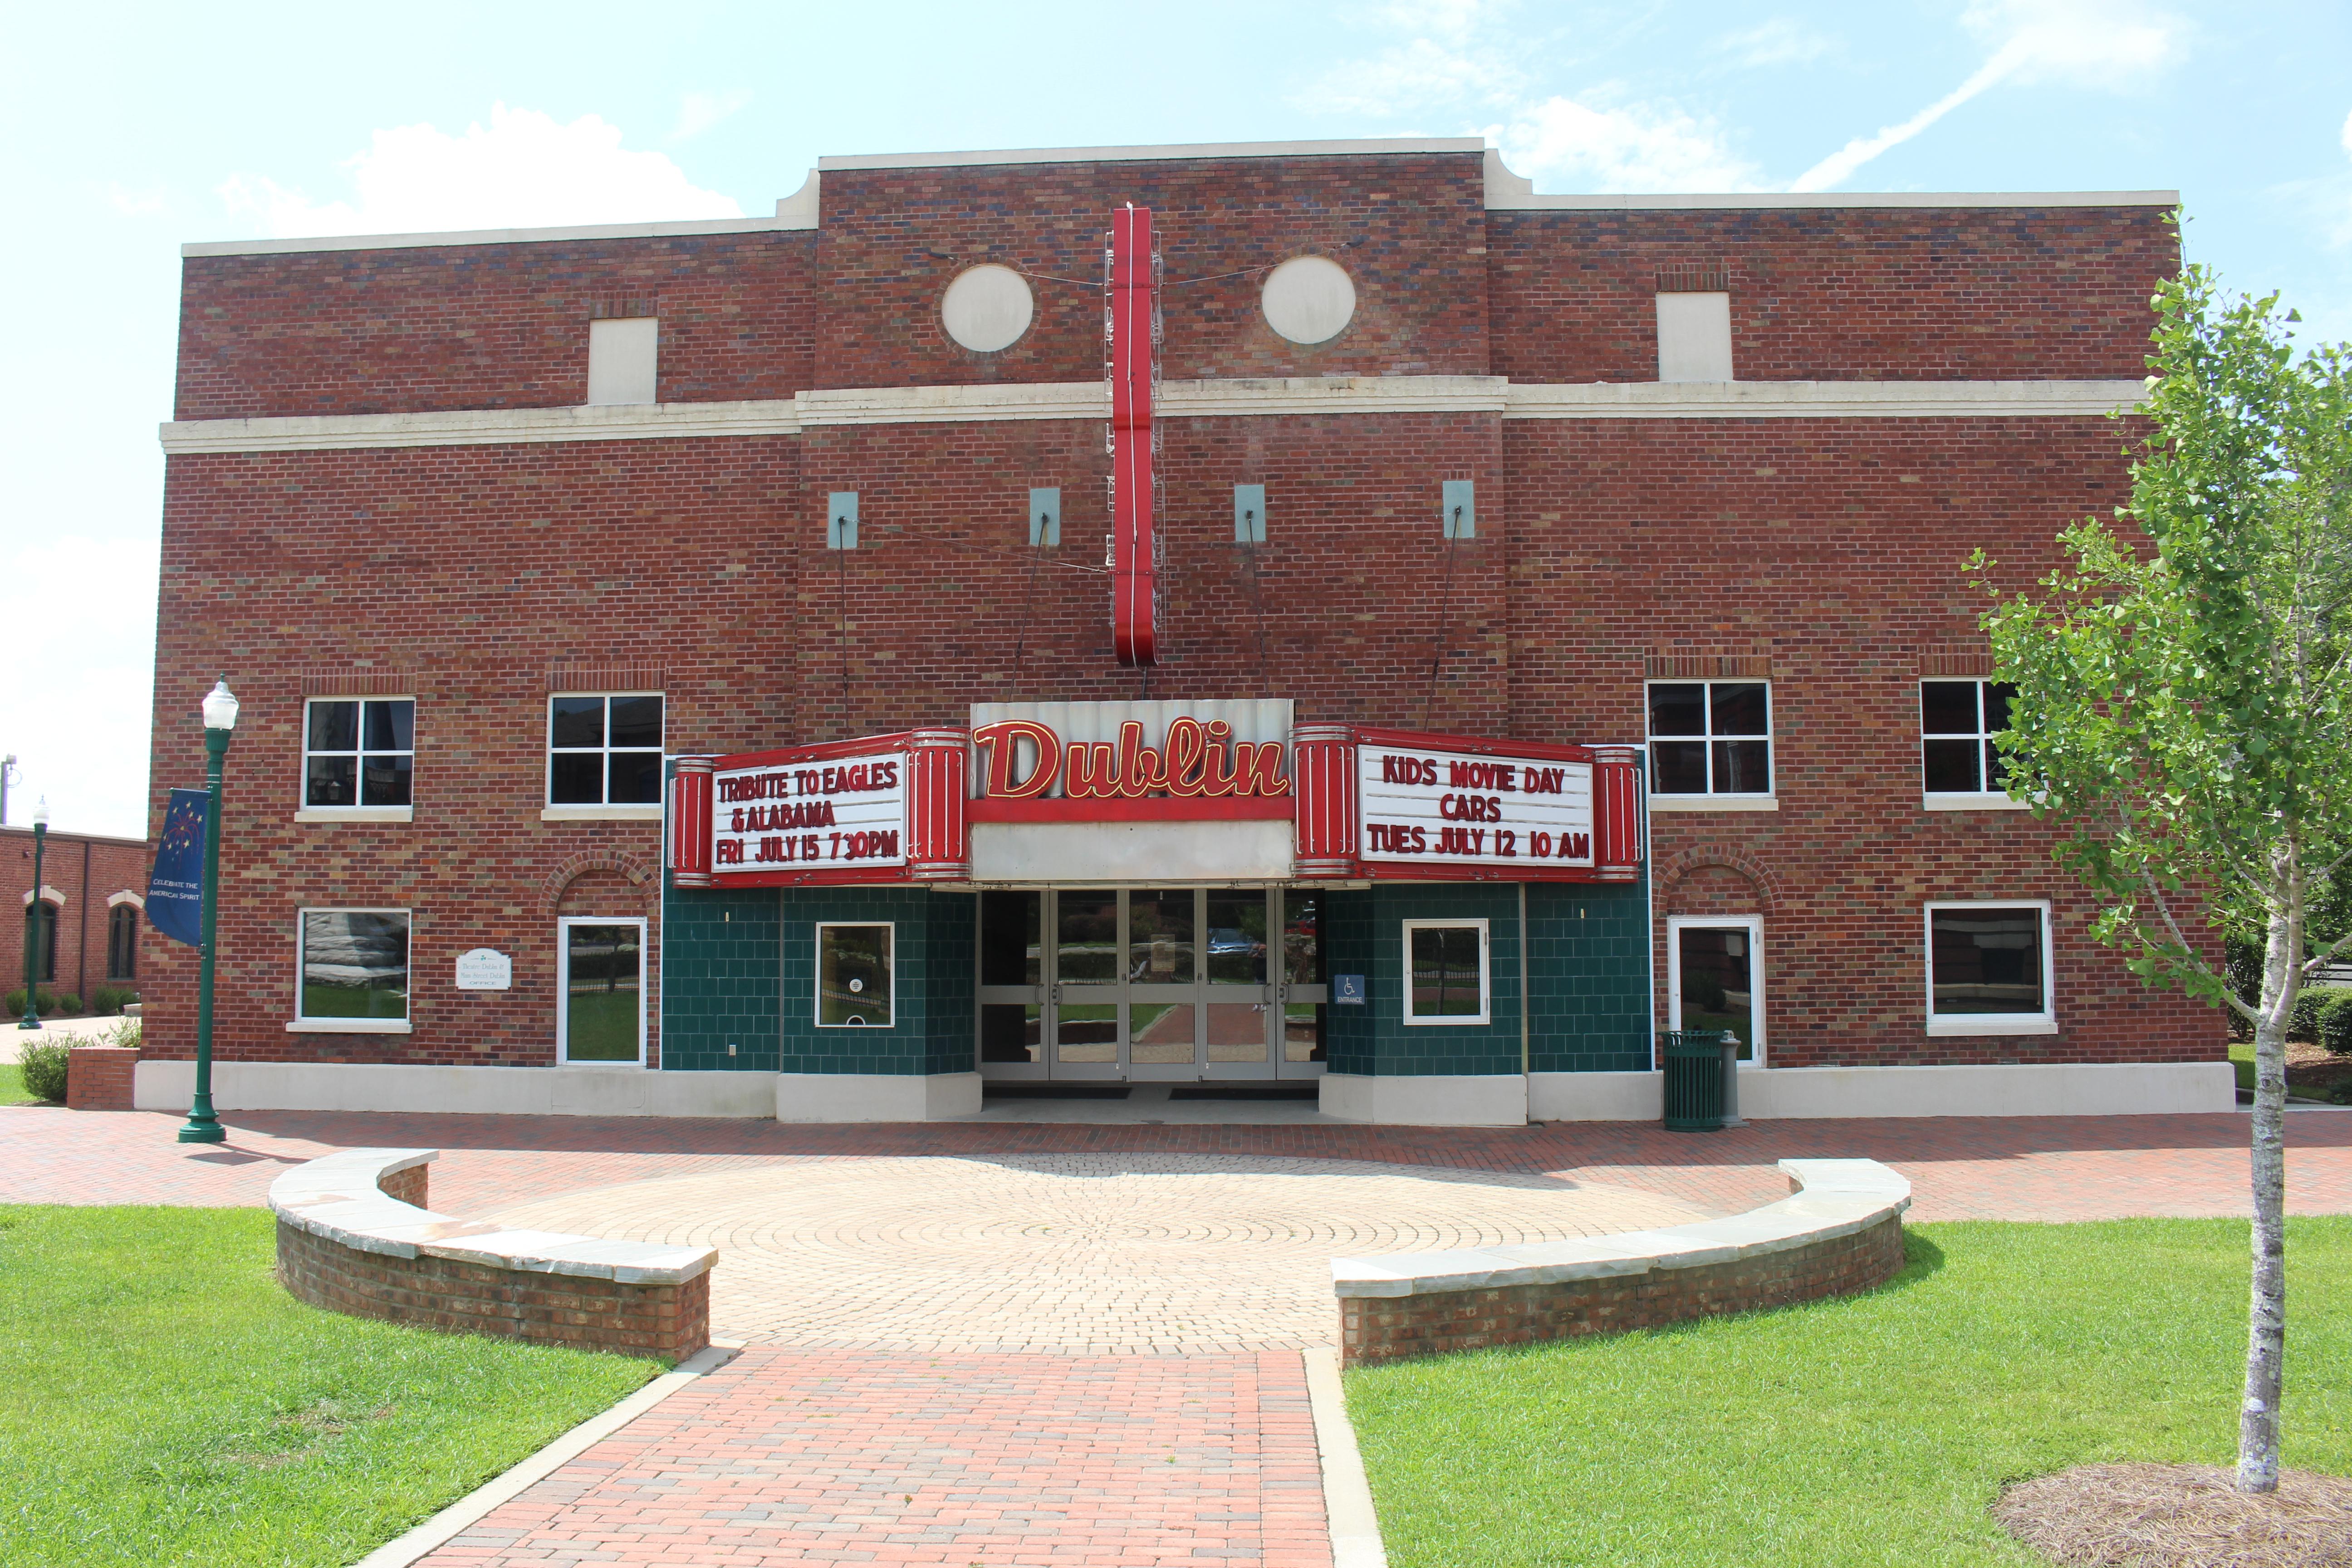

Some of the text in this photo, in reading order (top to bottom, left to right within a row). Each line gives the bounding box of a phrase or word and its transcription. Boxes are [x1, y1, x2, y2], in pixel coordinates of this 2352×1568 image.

[972, 716, 1291, 798] Dublin
[718, 761, 897, 802] TRIBUTE TO EAGLES
[1383, 755, 1564, 794] KIDS MOVIE DAY
[746, 800, 835, 831] ALABAMA
[1440, 794, 1501, 822] CARS
[717, 838, 743, 863] FRI
[755, 836, 796, 861] JULY
[802, 834, 819, 860] 15
[1367, 824, 1589, 858] TUES JULY 12 10 AM
[149, 890, 178, 898] AMERICAN
[153, 879, 184, 887] CELEBATE
